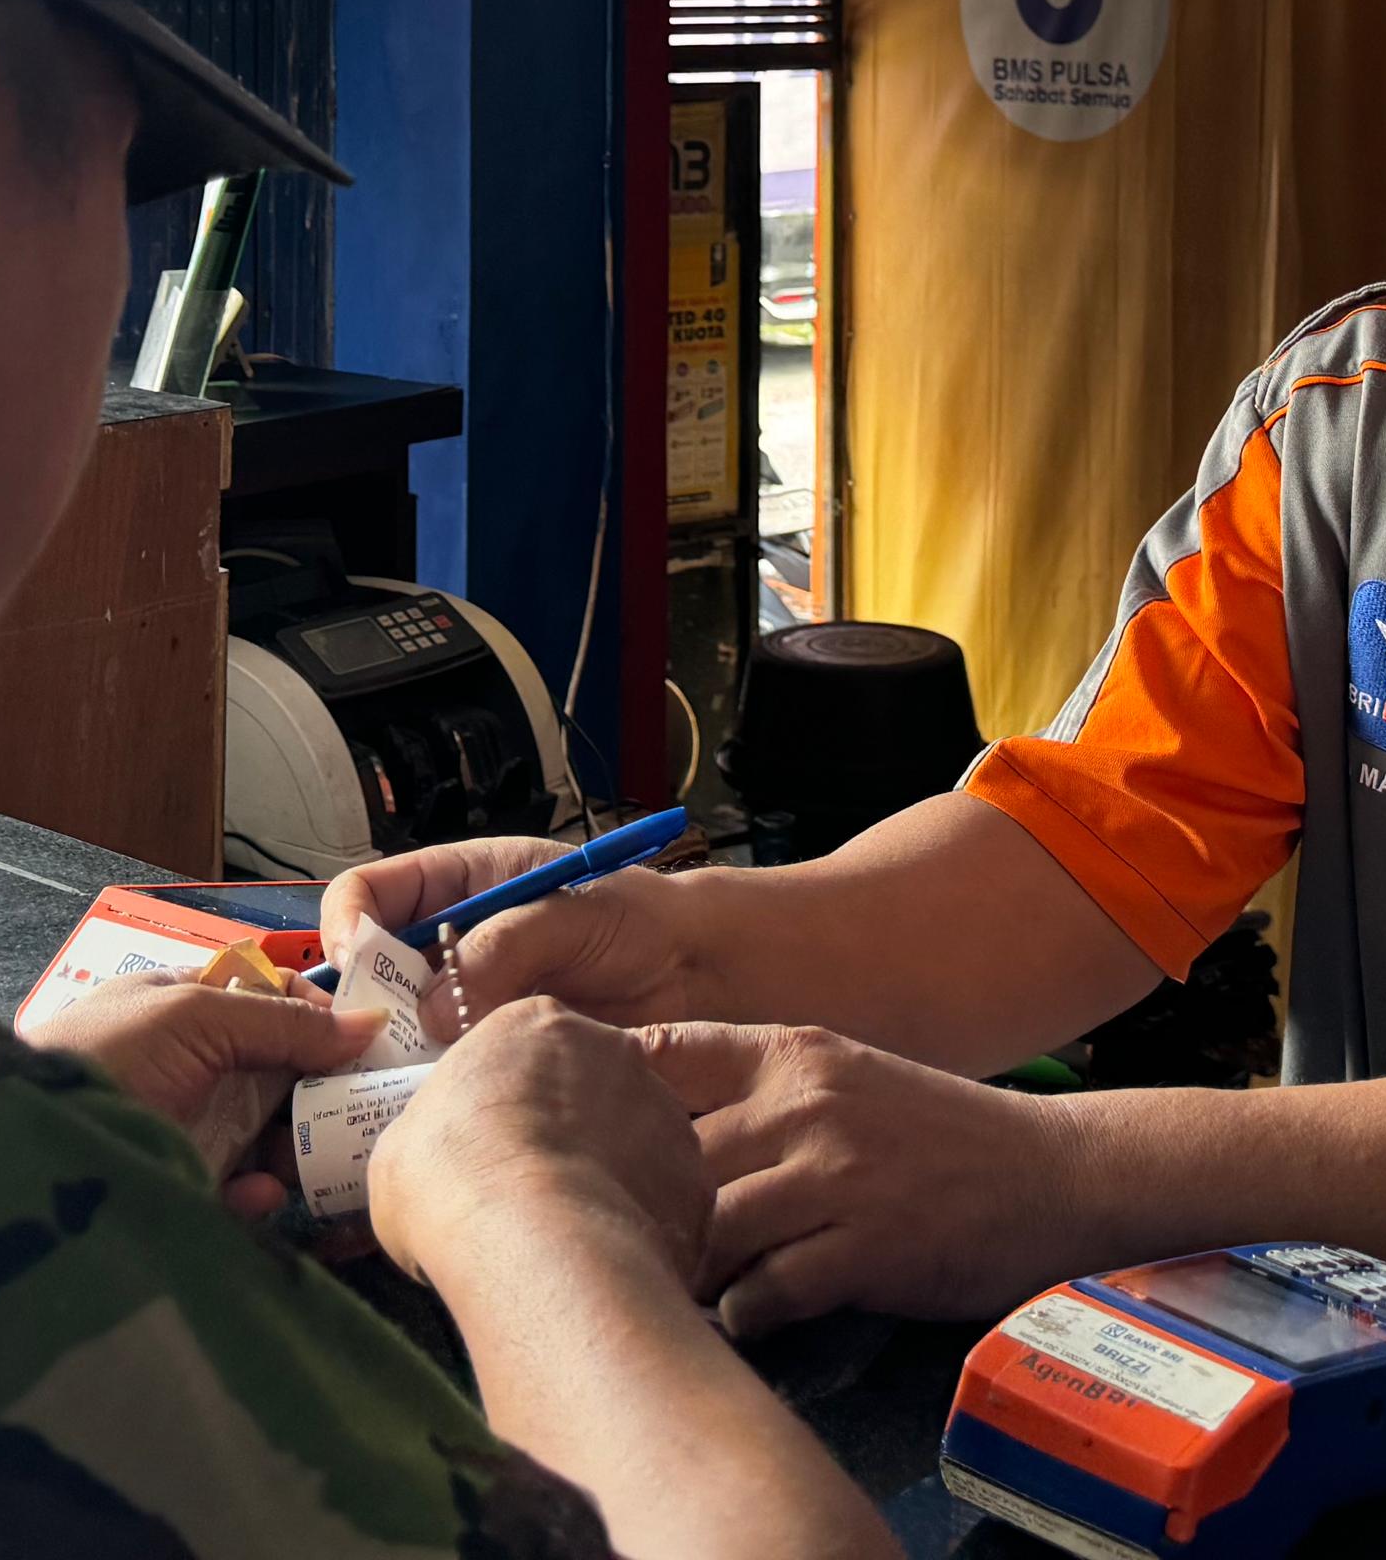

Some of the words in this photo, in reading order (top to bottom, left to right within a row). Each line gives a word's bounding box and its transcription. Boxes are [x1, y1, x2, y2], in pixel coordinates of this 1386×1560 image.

[993, 58, 1043, 82] BMS
[1051, 60, 1129, 86] PULSA
[994, 84, 1065, 103] Sahabat
[1070, 88, 1130, 109] Semua
[1093, 1343, 1151, 1375] BRIZZI
[1123, 1333, 1158, 1353] BANK
[1160, 1347, 1183, 1364] BRI
